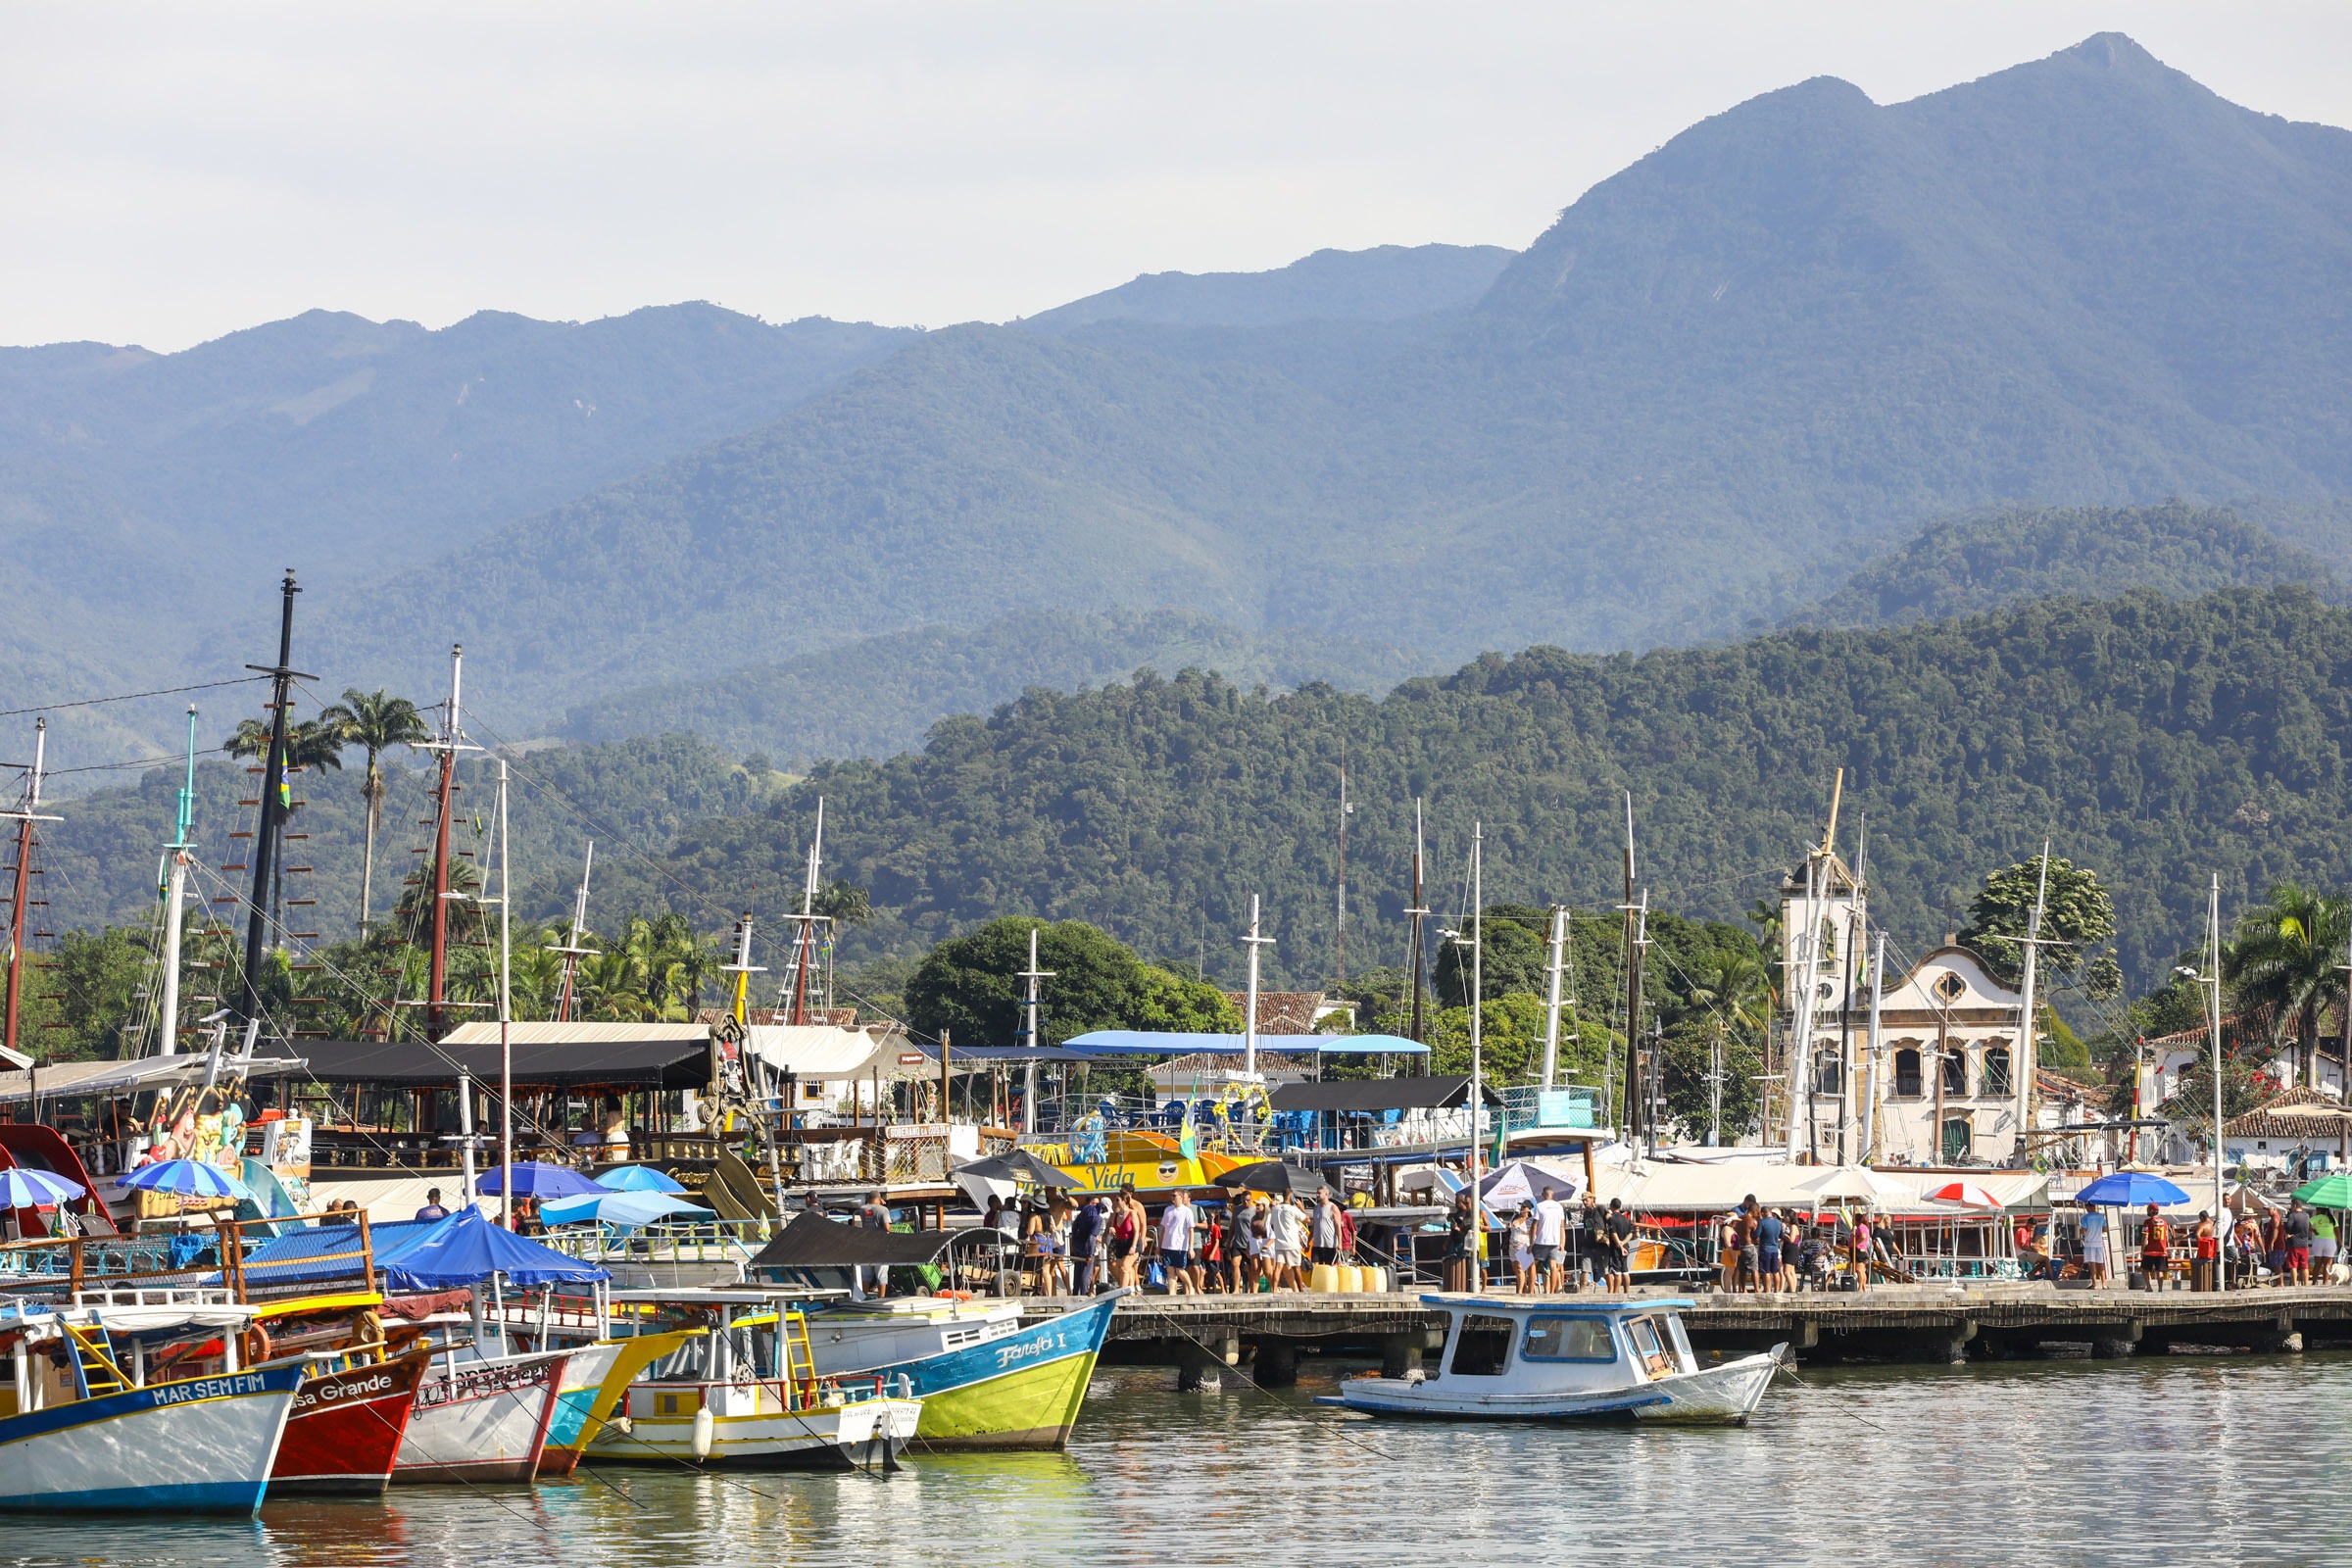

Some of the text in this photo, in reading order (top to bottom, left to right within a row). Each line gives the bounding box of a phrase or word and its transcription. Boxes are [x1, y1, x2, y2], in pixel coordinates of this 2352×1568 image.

[890, 1126, 920, 1139] SOBERANO
[1086, 1164, 1135, 1190] Vida
[2153, 1226, 2165, 1241] 51
[152, 1373, 266, 1405] MAR SEM FIM
[319, 1374, 392, 1400] Grande
